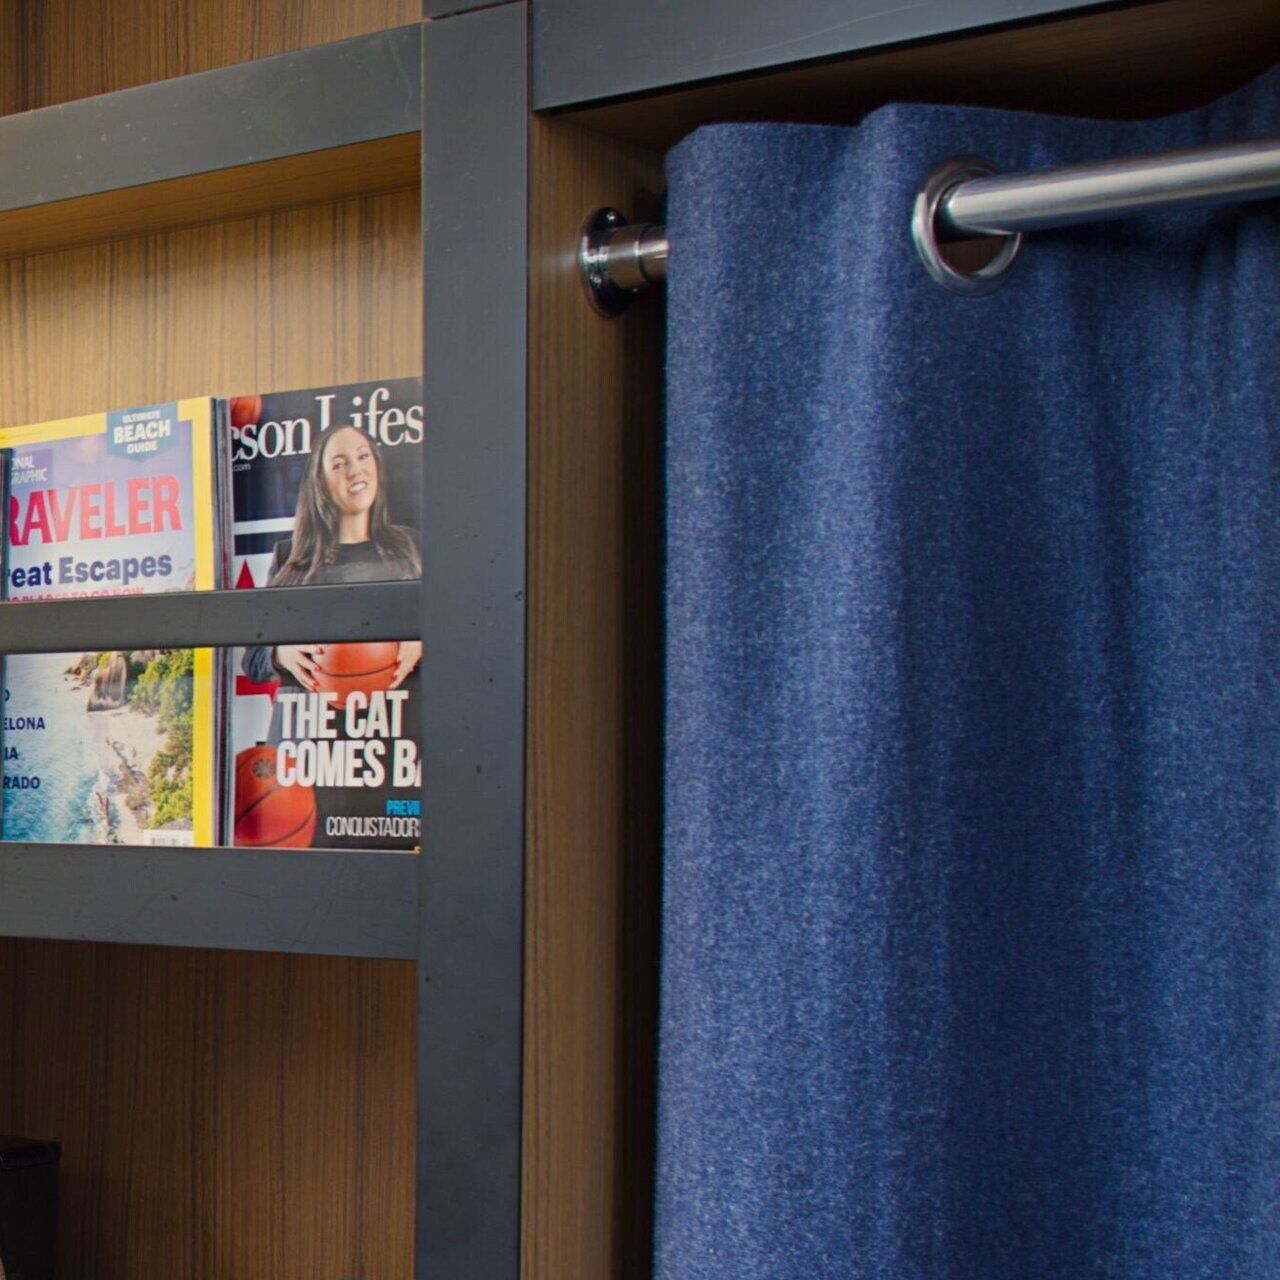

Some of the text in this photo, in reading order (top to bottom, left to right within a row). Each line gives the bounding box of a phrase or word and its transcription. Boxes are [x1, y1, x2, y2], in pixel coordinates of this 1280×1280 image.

[113, 419, 171, 444] BEACH
[126, 442, 158, 455] GUIDE
[8, 554, 173, 588] eat Escapes
[277, 691, 409, 739] THE CAT
[276, 740, 386, 788] COMES
[326, 817, 421, 837] CONQUISTADOR
